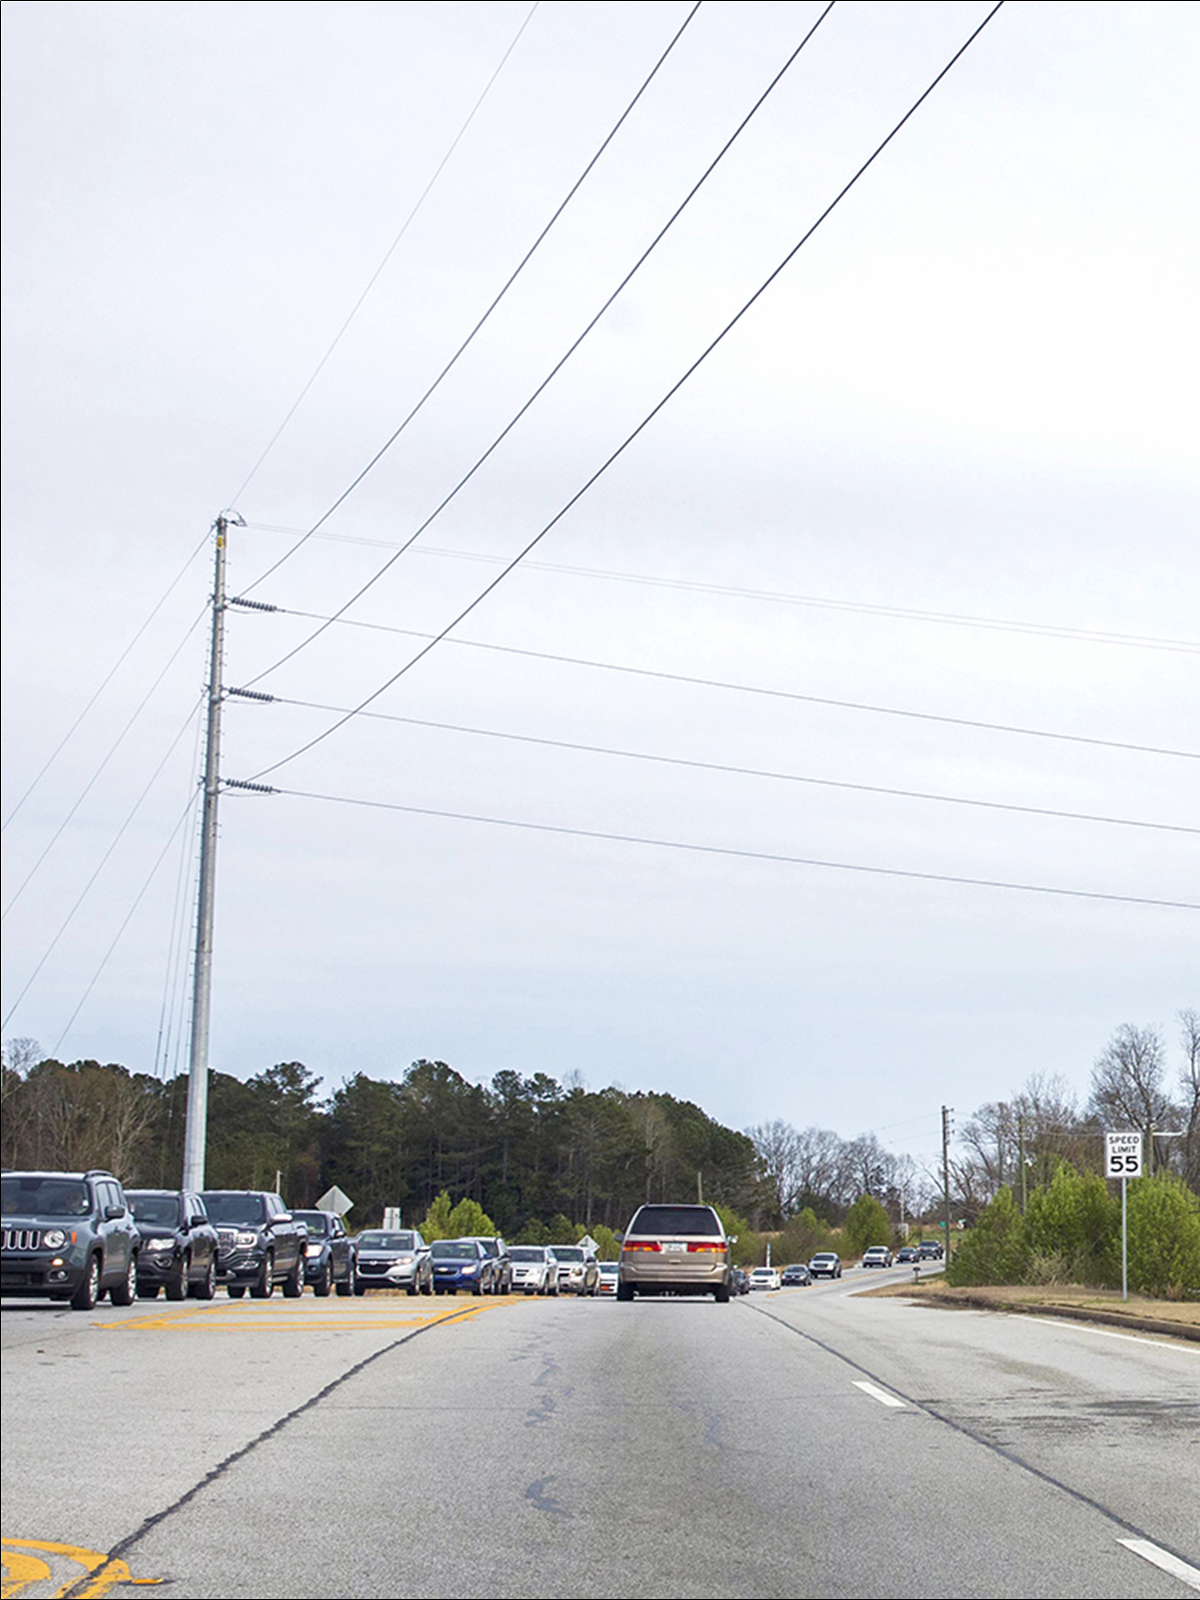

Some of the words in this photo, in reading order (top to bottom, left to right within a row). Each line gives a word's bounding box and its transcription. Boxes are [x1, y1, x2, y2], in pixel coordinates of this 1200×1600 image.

[1109, 1136, 1140, 1145] SPEED
[1112, 1146, 1137, 1154] LIMIT
[1110, 1155, 1139, 1173] 55
